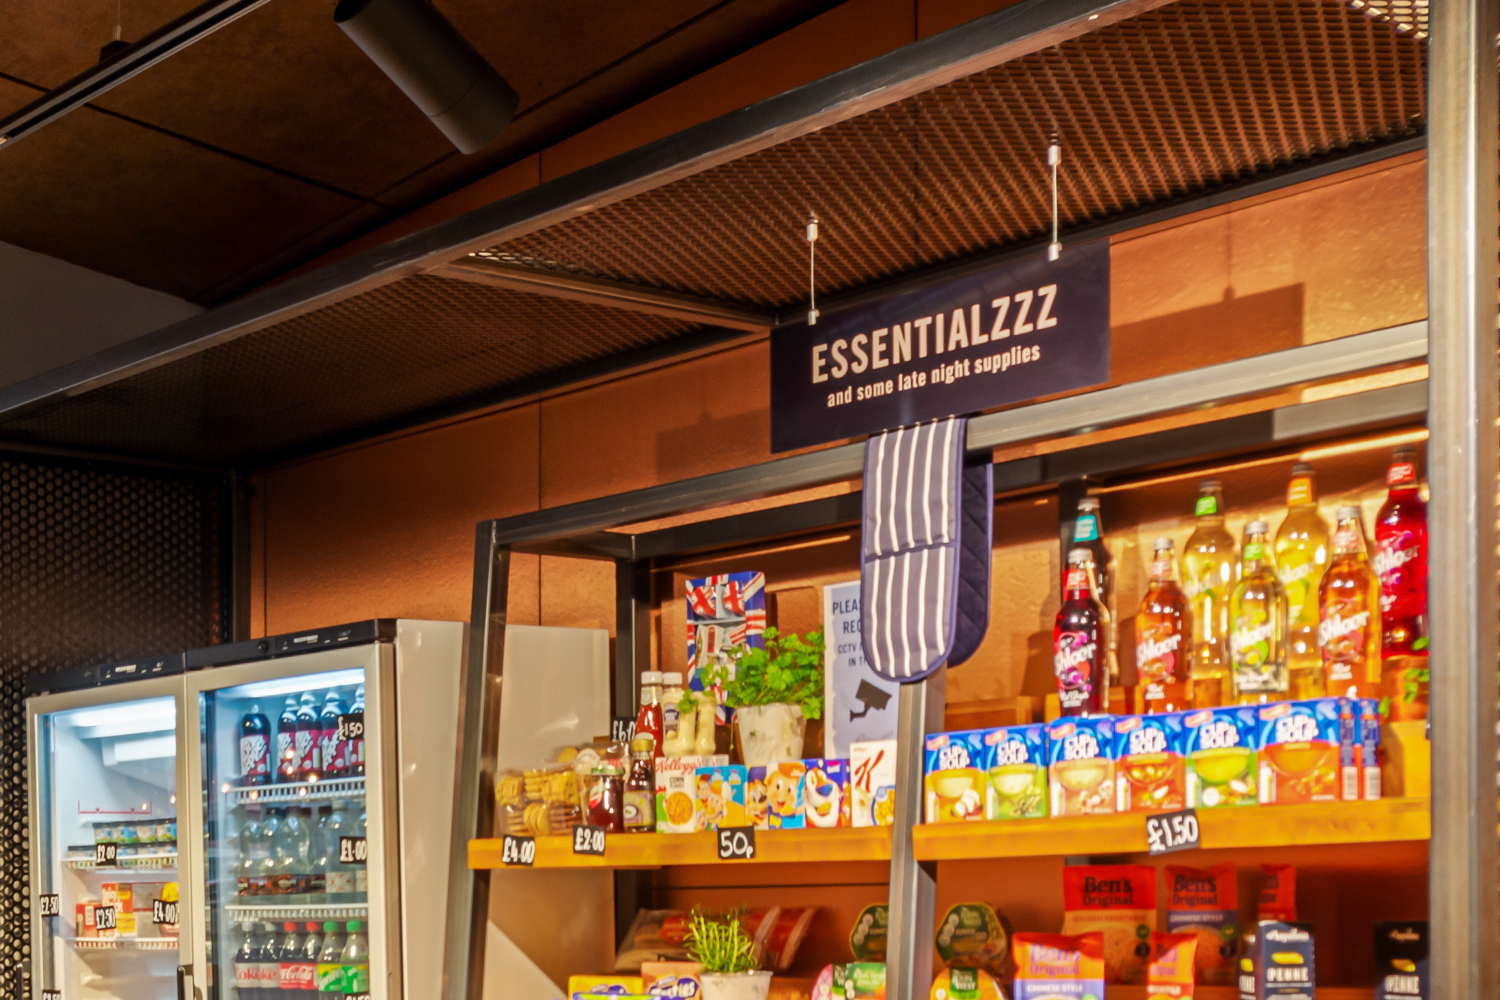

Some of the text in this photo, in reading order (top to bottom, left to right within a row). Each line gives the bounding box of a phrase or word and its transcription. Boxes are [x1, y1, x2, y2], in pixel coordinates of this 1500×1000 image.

[811, 283, 1058, 384] ESSENTIALZZZ
[827, 343, 1041, 407] and some late night supplies
[833, 599, 861, 615] PLEA
[655, 757, 701, 775] Kellogg's
[575, 827, 605, 852] £2.00
[1147, 815, 1198, 851] £1.50
[502, 837, 535, 864] £4.00
[720, 831, 753, 859] 50p
[1084, 876, 1133, 893] Ben's
[1173, 875, 1217, 893] Ben's
[1083, 893, 1133, 908] Original
[1267, 967, 1309, 982] PENNE
